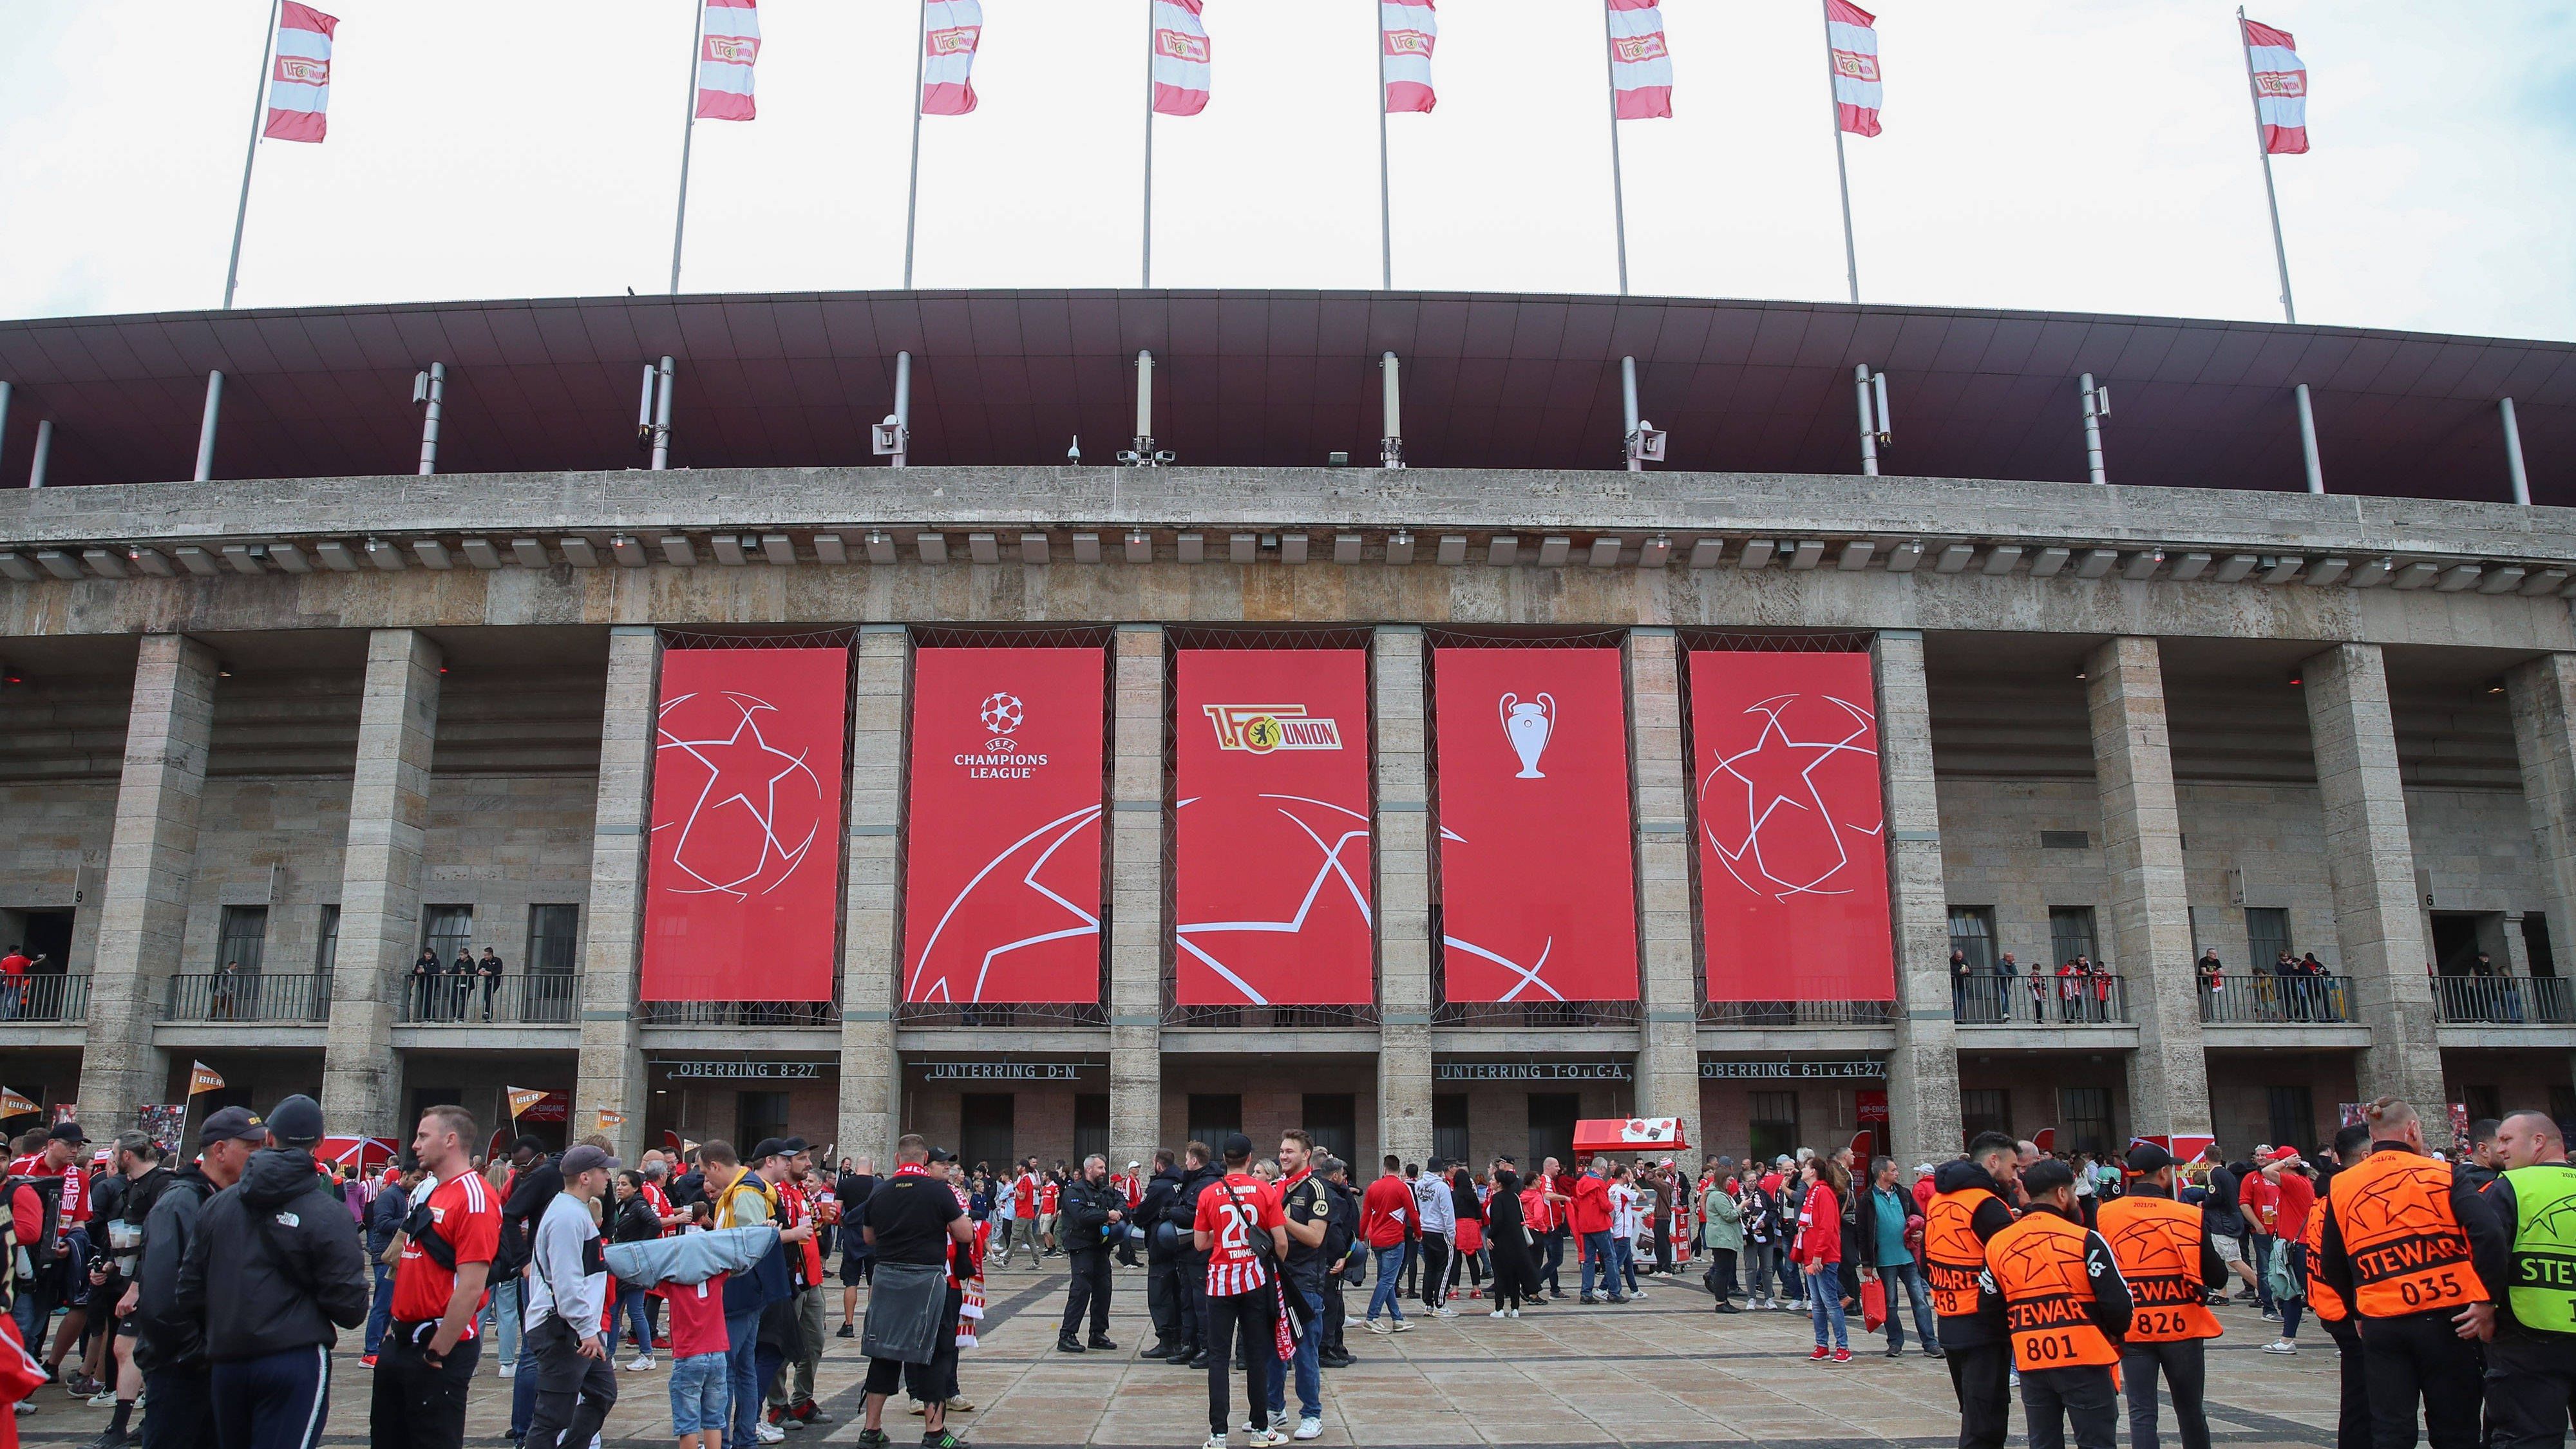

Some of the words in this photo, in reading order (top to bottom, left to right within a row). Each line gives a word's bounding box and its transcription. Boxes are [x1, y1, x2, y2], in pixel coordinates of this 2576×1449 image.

[1281, 723, 1336, 744] UNION
[986, 740, 1016, 752] UEFA
[954, 754, 1048, 766] CHAMPIONS
[76, 890, 83, 903] 9
[2426, 894, 2433, 906] 6
[679, 1063, 768, 1076] OBERRING
[780, 1064, 815, 1077] 8-27
[935, 1064, 1036, 1077] UNTERRING
[1048, 1065, 1075, 1078] D-N
[1441, 1065, 1540, 1077] UNTERRING
[1703, 1063, 1790, 1076] OBERRING
[1802, 1063, 1823, 1076] 6-1
[1843, 1063, 1881, 1076] 41-27
[198, 1075, 222, 1087] BIER
[516, 1093, 540, 1104] BIER
[8, 1100, 32, 1112] BIER
[601, 1114, 620, 1123] BIER
[1234, 1185, 1256, 1194] UNION
[1314, 1204, 1327, 1213] JD
[1219, 1204, 1258, 1249] 28
[2356, 1237, 2467, 1280] STEWAR
[2127, 1278, 2201, 1303] EWAR
[2400, 1272, 2463, 1306] 035
[2007, 1298, 2089, 1330] STEWAR
[2137, 1312, 2186, 1335] 826
[2026, 1334, 2078, 1362] 801
